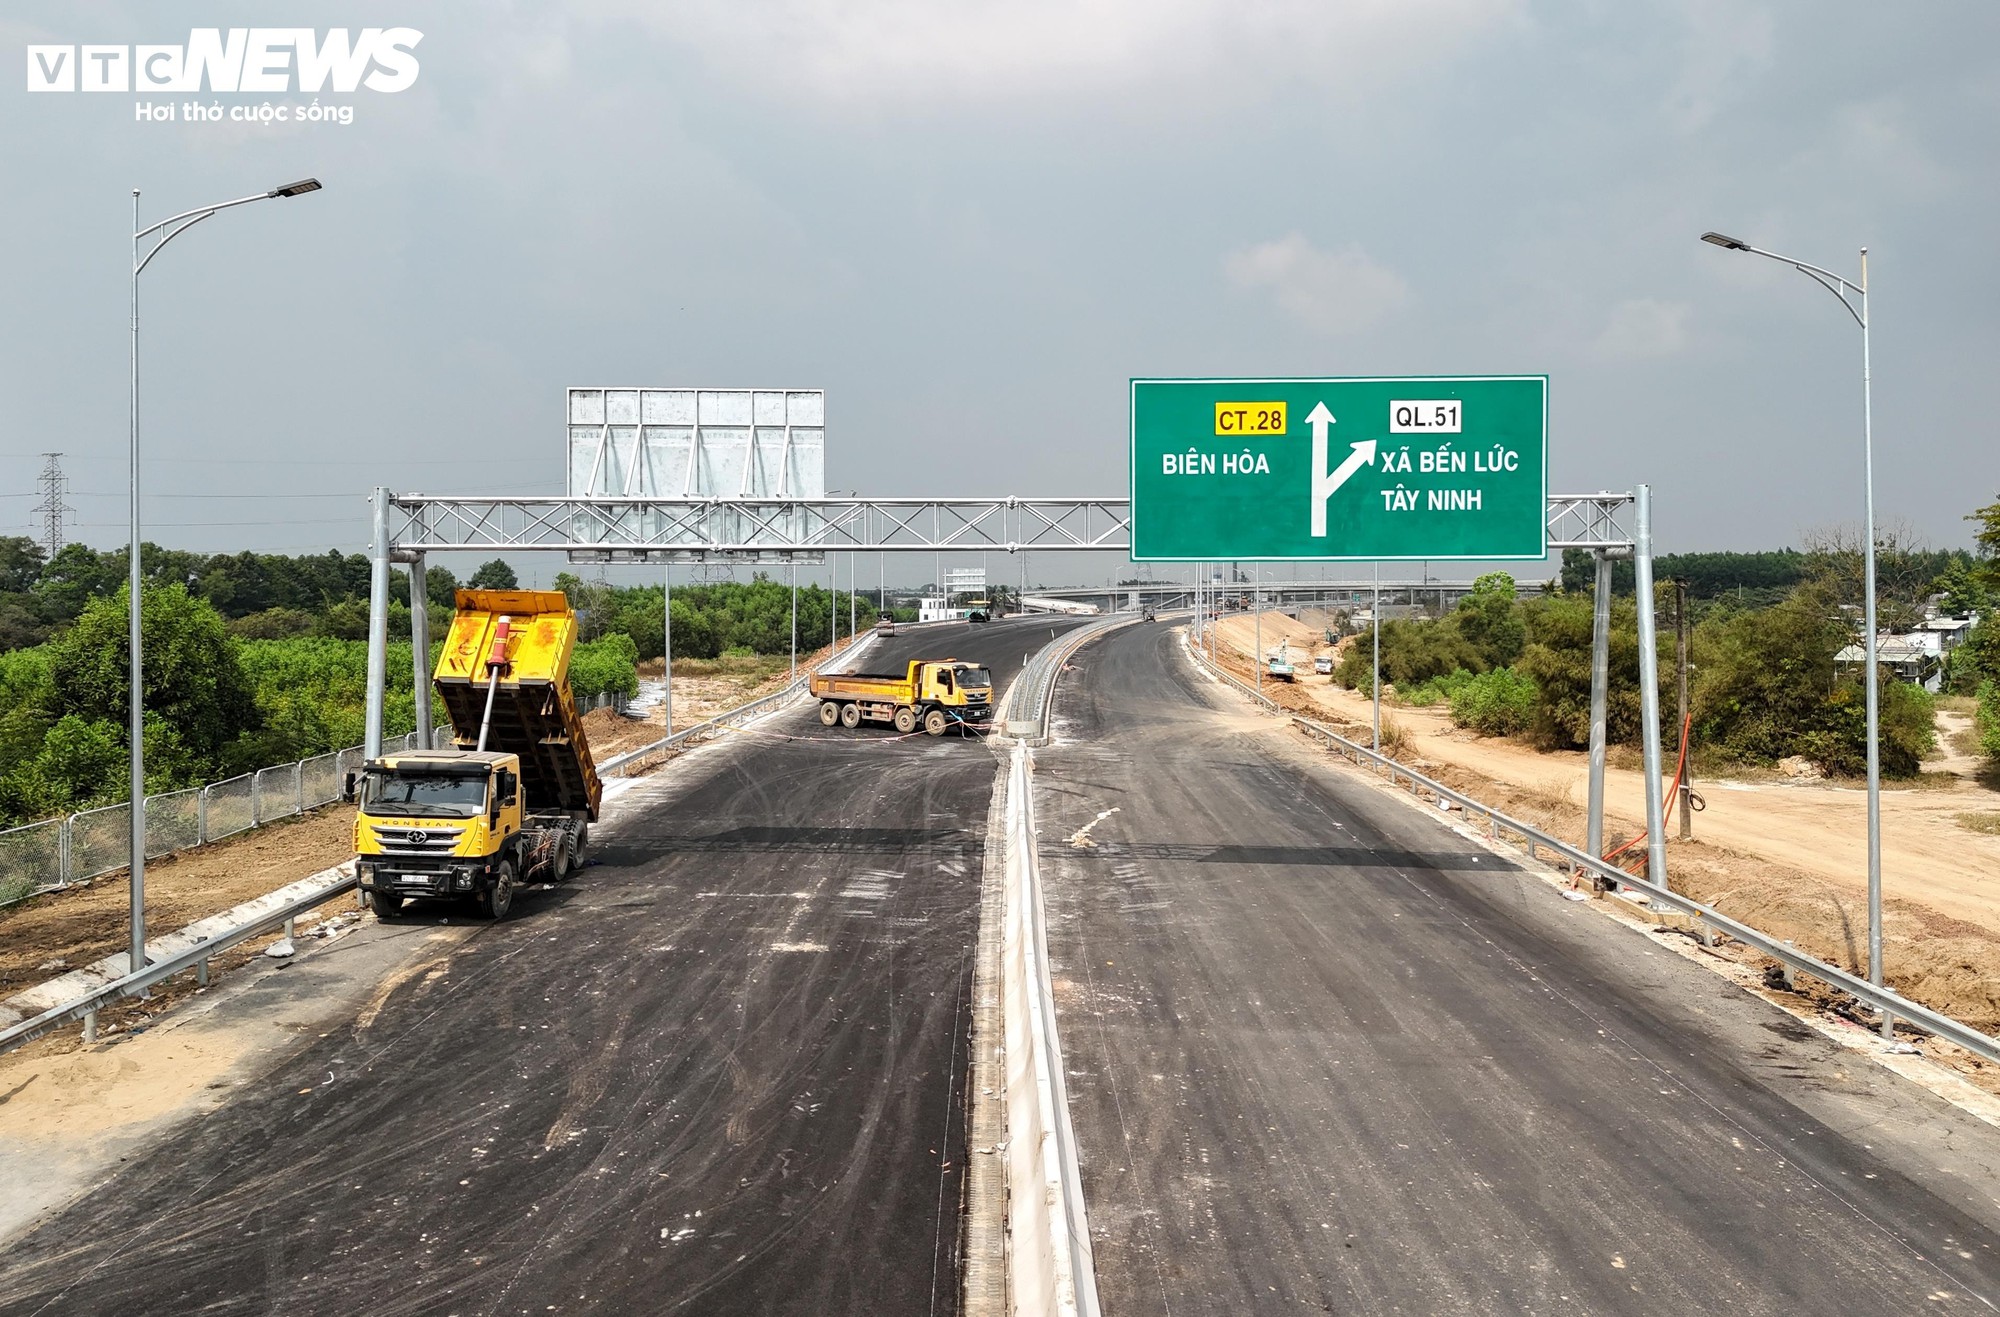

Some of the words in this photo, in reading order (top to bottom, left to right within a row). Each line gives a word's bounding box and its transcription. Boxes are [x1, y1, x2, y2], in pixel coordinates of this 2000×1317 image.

[1219, 410, 1282, 431] CT.28
[1396, 407, 1457, 428] QL.51
[1162, 447, 1216, 475] BIÊN
[1223, 448, 1270, 475] HÒA
[1381, 446, 1413, 474] XÃ
[1420, 442, 1466, 473] BẾN
[1474, 443, 1519, 472] LỨC
[1381, 483, 1420, 512] TÂY
[1428, 489, 1482, 511] NINH
